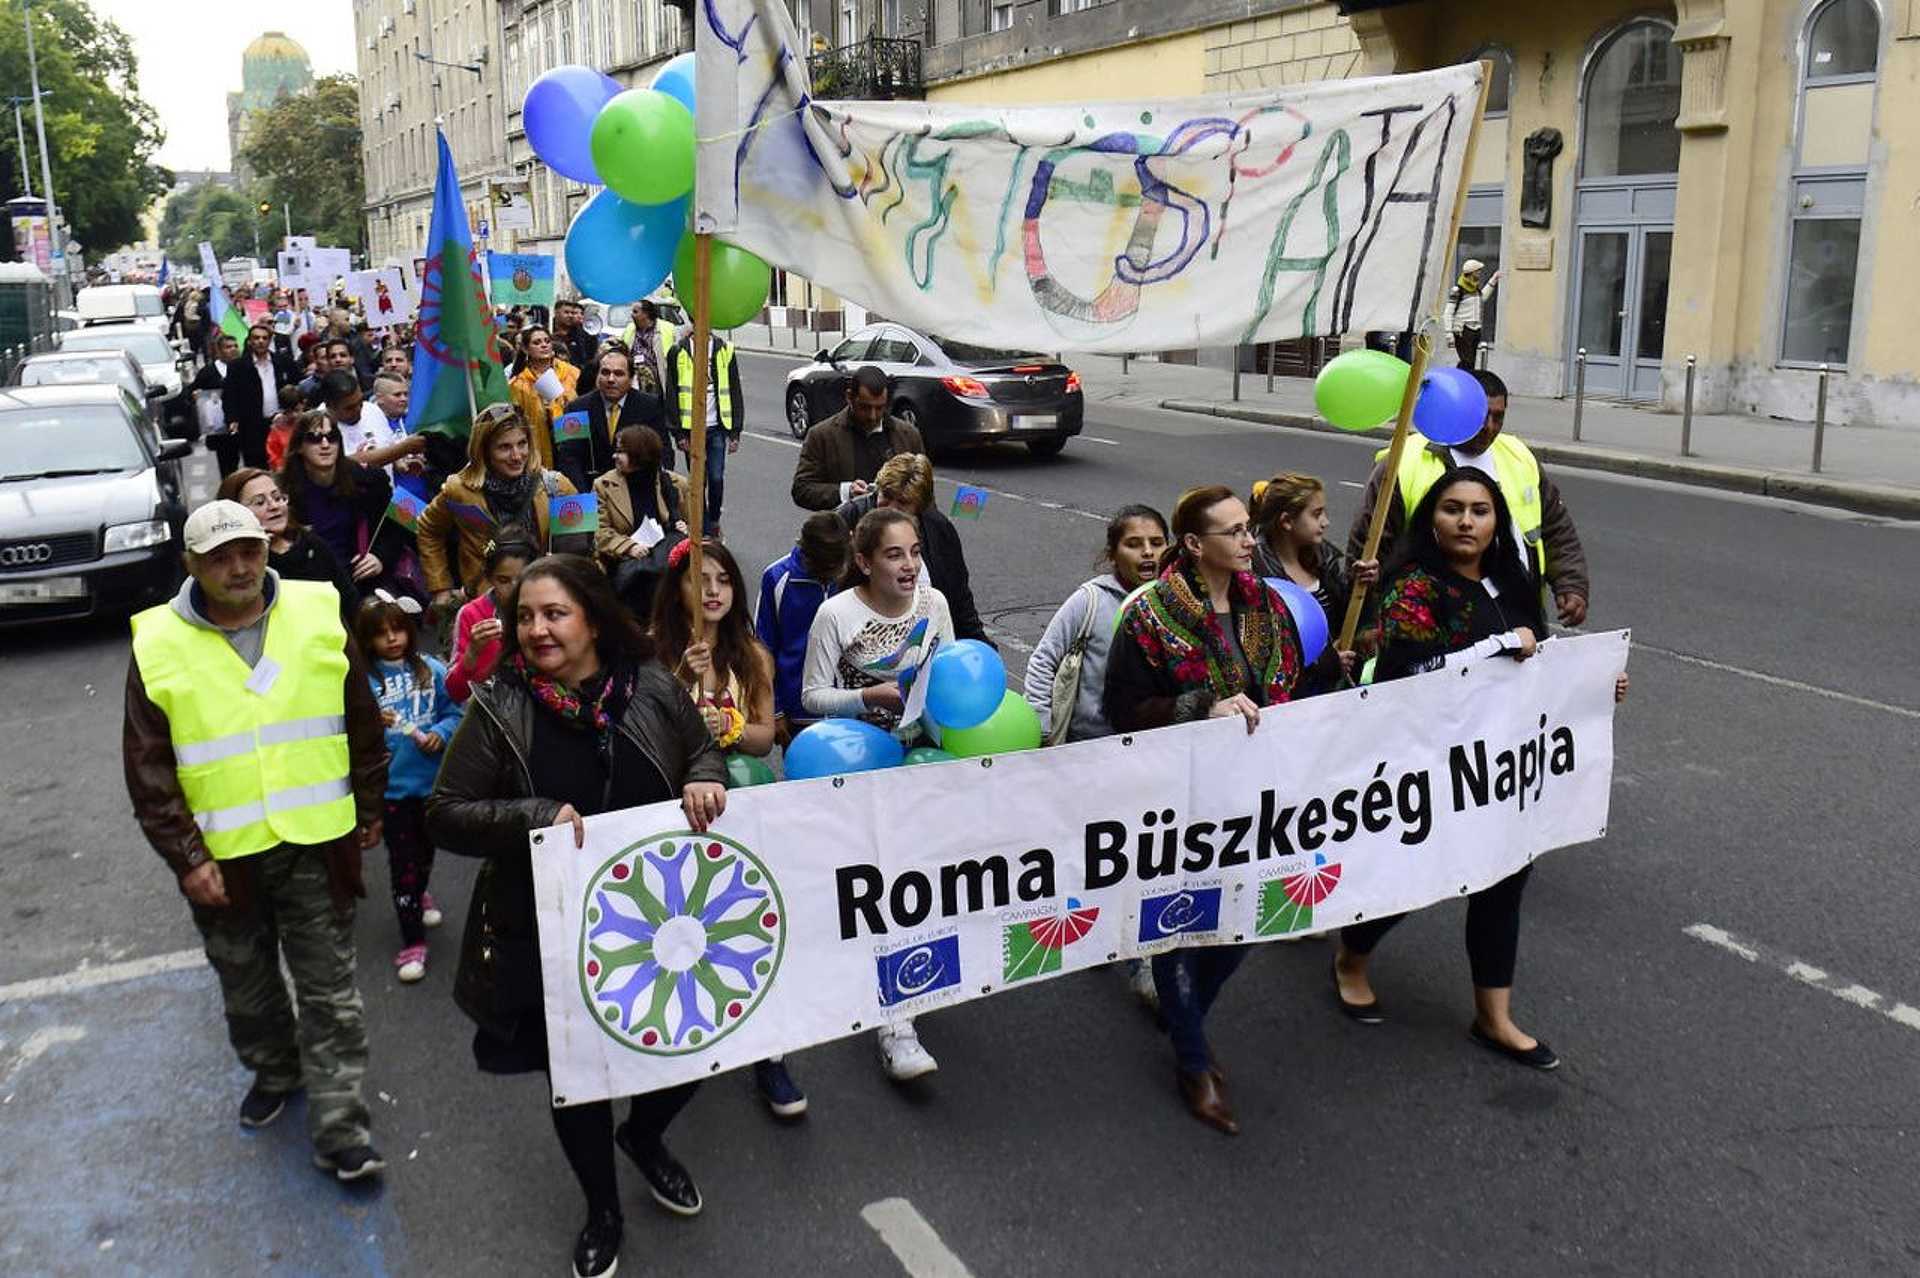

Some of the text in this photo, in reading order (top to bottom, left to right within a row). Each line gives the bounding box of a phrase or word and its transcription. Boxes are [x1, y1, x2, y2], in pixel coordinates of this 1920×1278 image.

[835, 713, 1576, 940] Roma Büszkeség Napja
